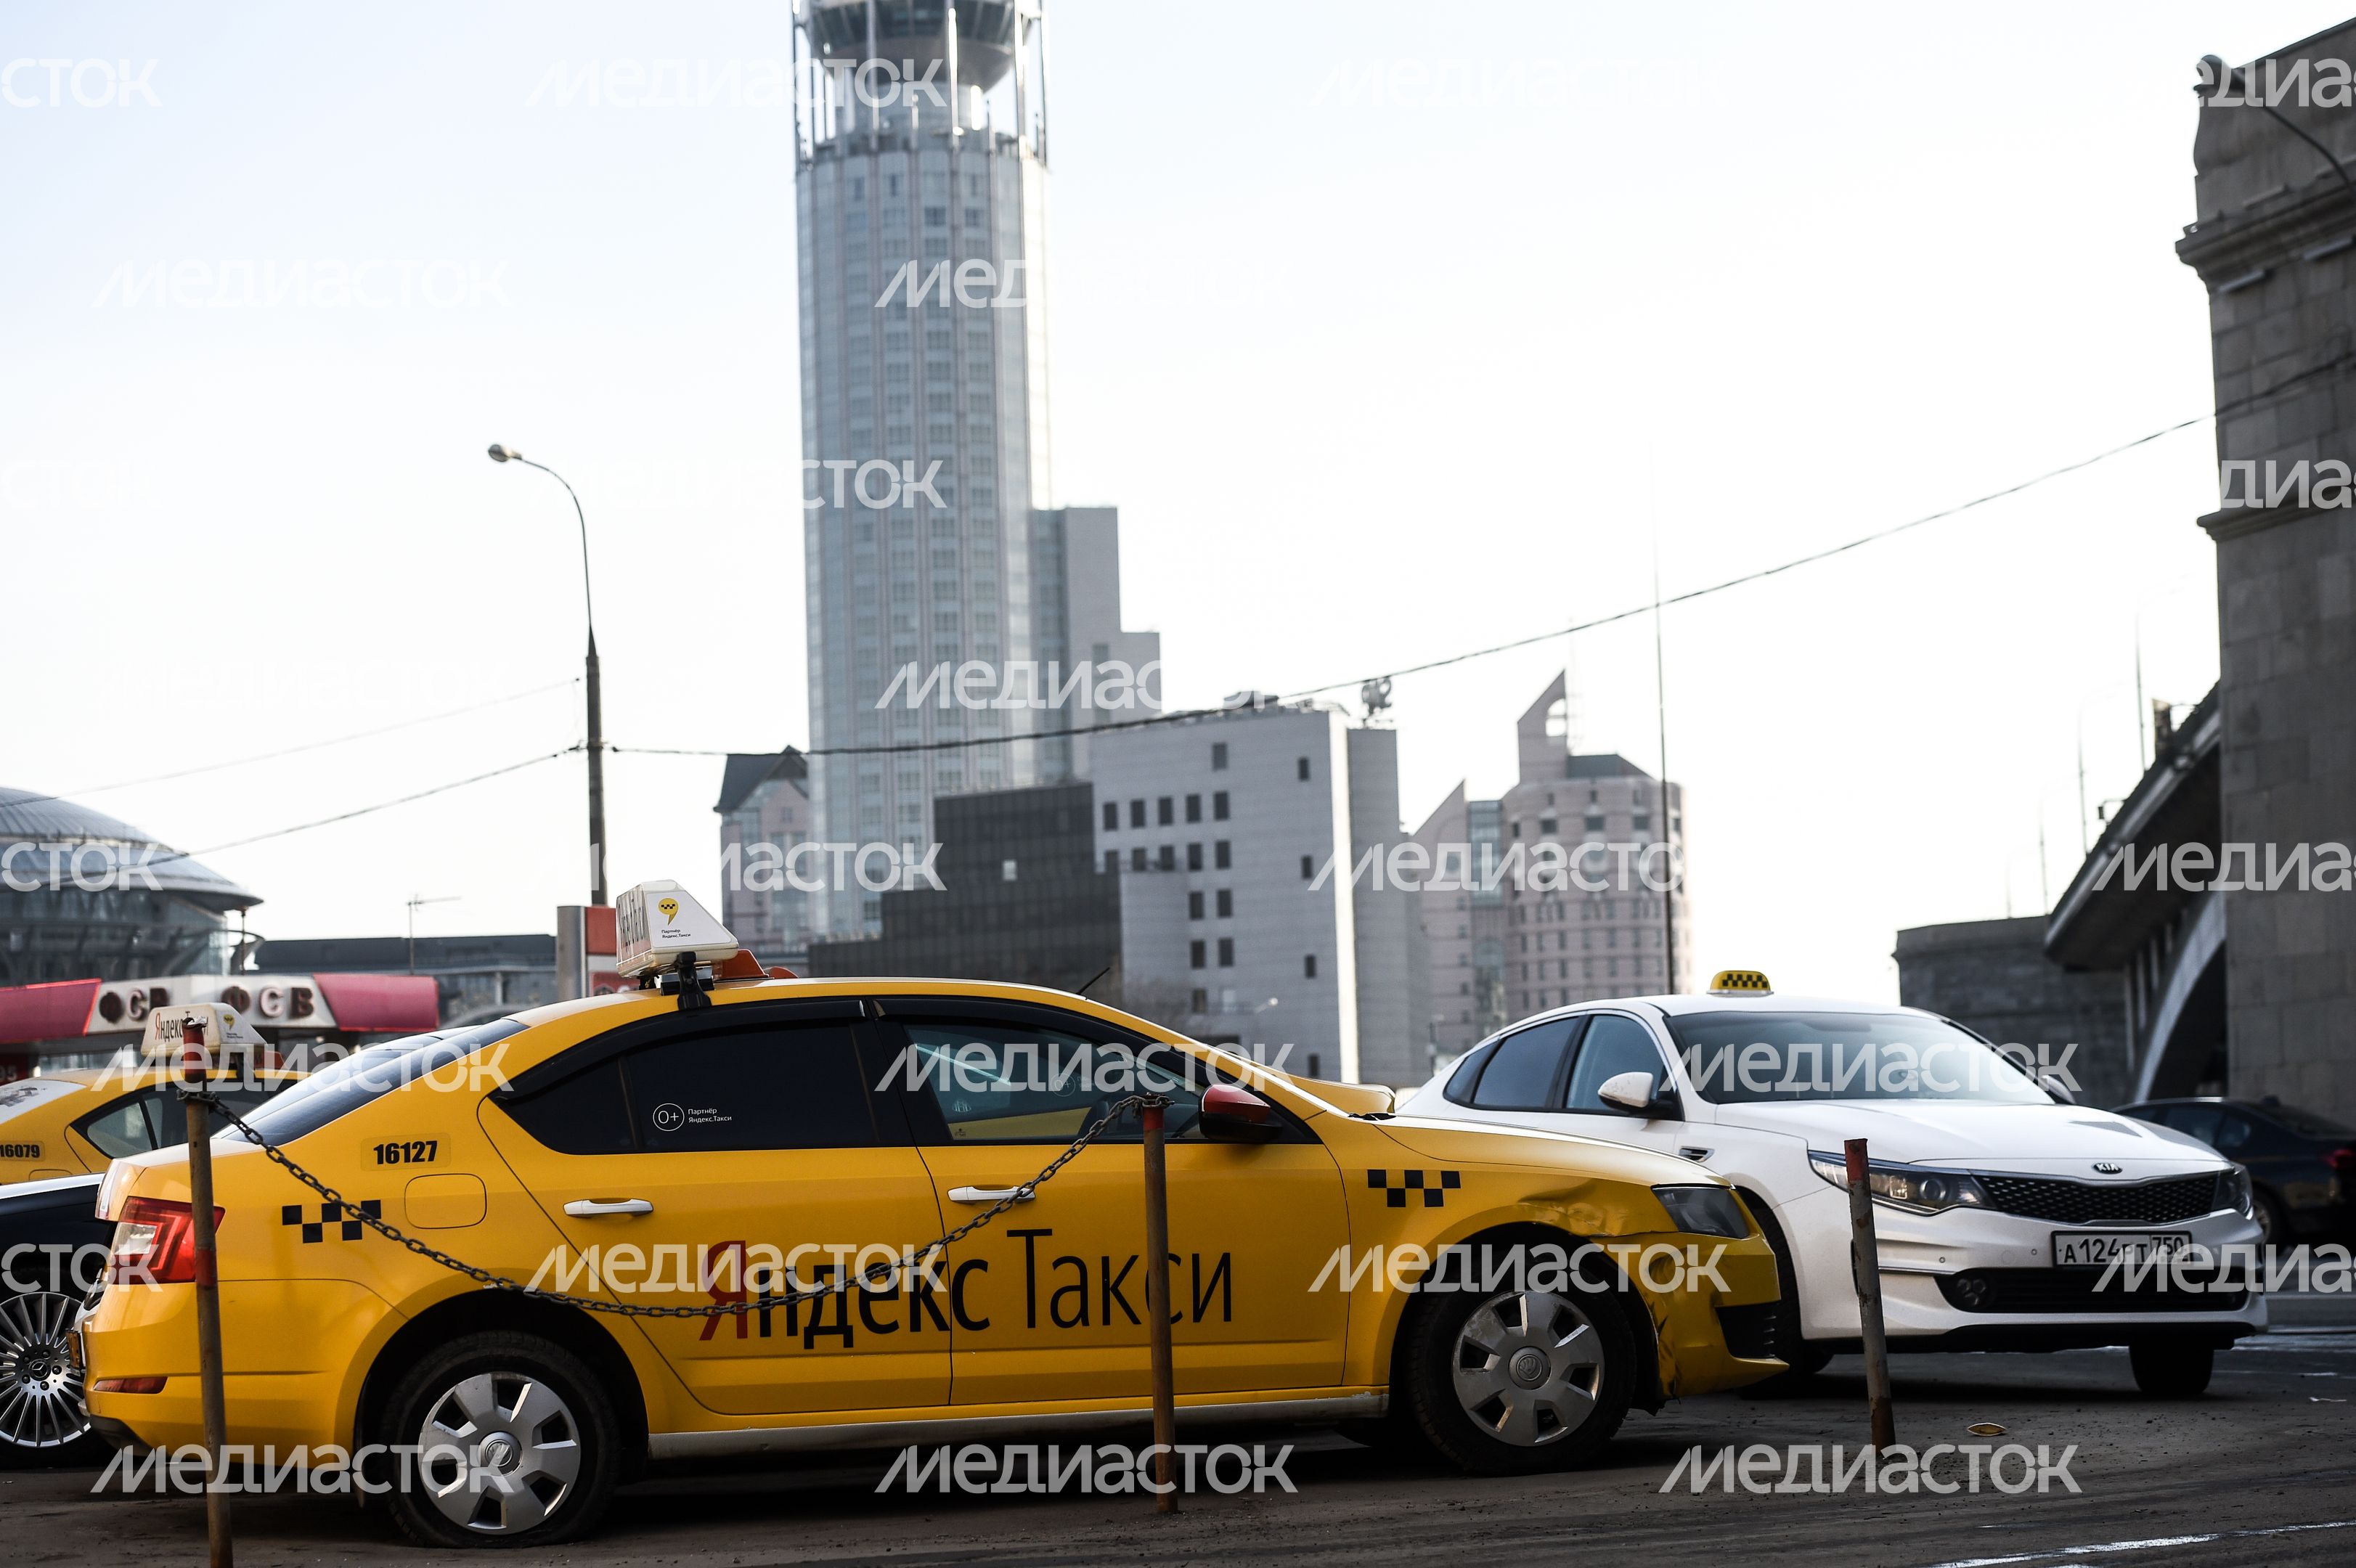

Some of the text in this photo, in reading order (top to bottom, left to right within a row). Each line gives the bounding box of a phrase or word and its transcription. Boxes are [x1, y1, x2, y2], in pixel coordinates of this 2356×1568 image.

[688, 1115, 732, 1124] Яндекс.Такси
[0, 1144, 41, 1159] 16079
[373, 1140, 438, 1164] 16127
[699, 1240, 990, 1349] Яндекс
